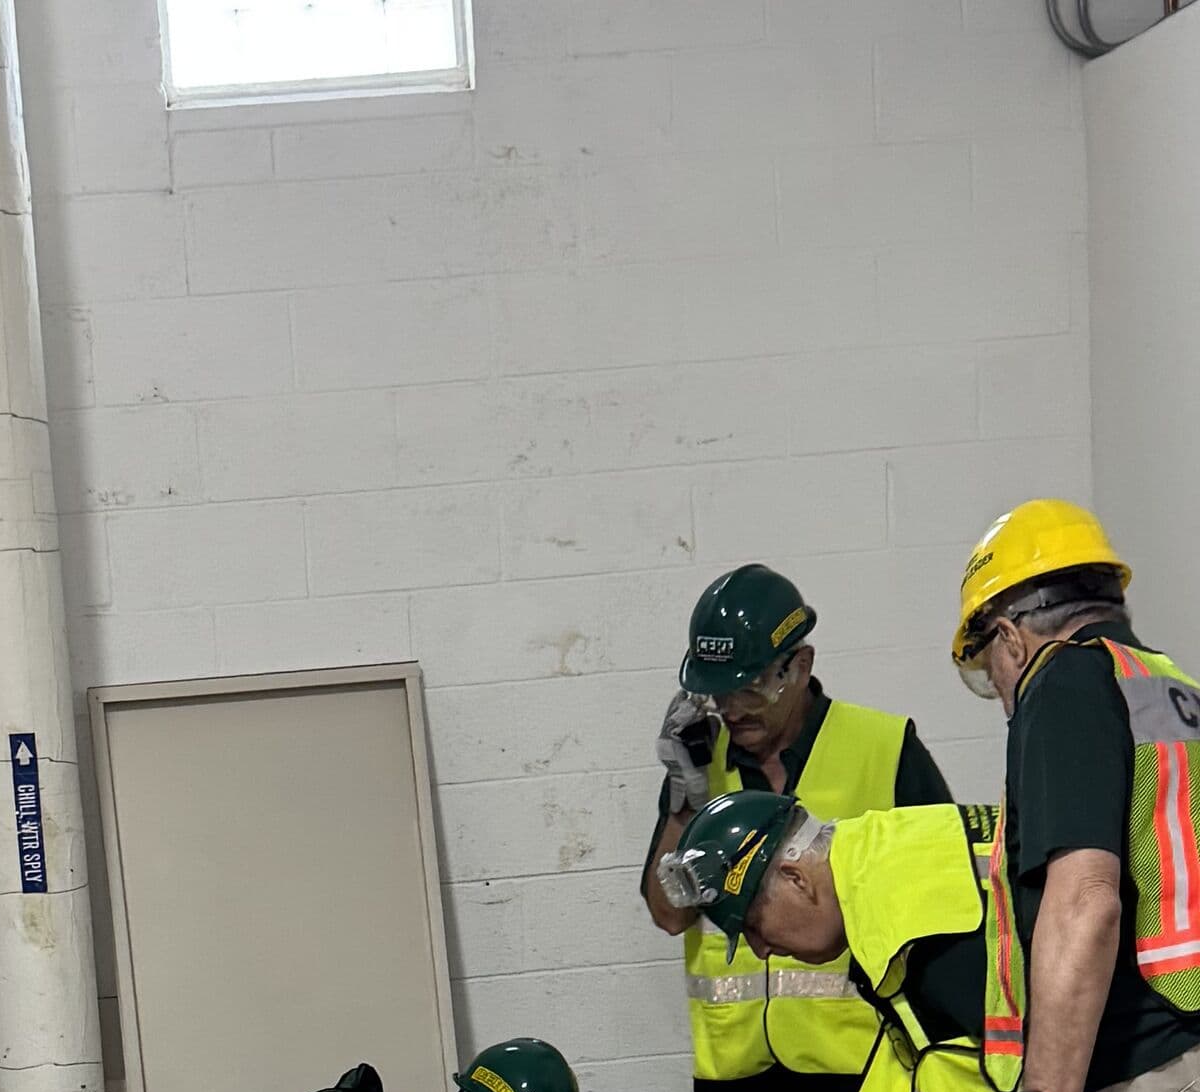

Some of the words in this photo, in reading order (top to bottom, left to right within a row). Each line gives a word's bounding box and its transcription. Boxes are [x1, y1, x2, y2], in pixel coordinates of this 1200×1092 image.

[17, 784, 37, 819] CHILL
[21, 821, 40, 850] WTR
[23, 854, 44, 882] SPLY
